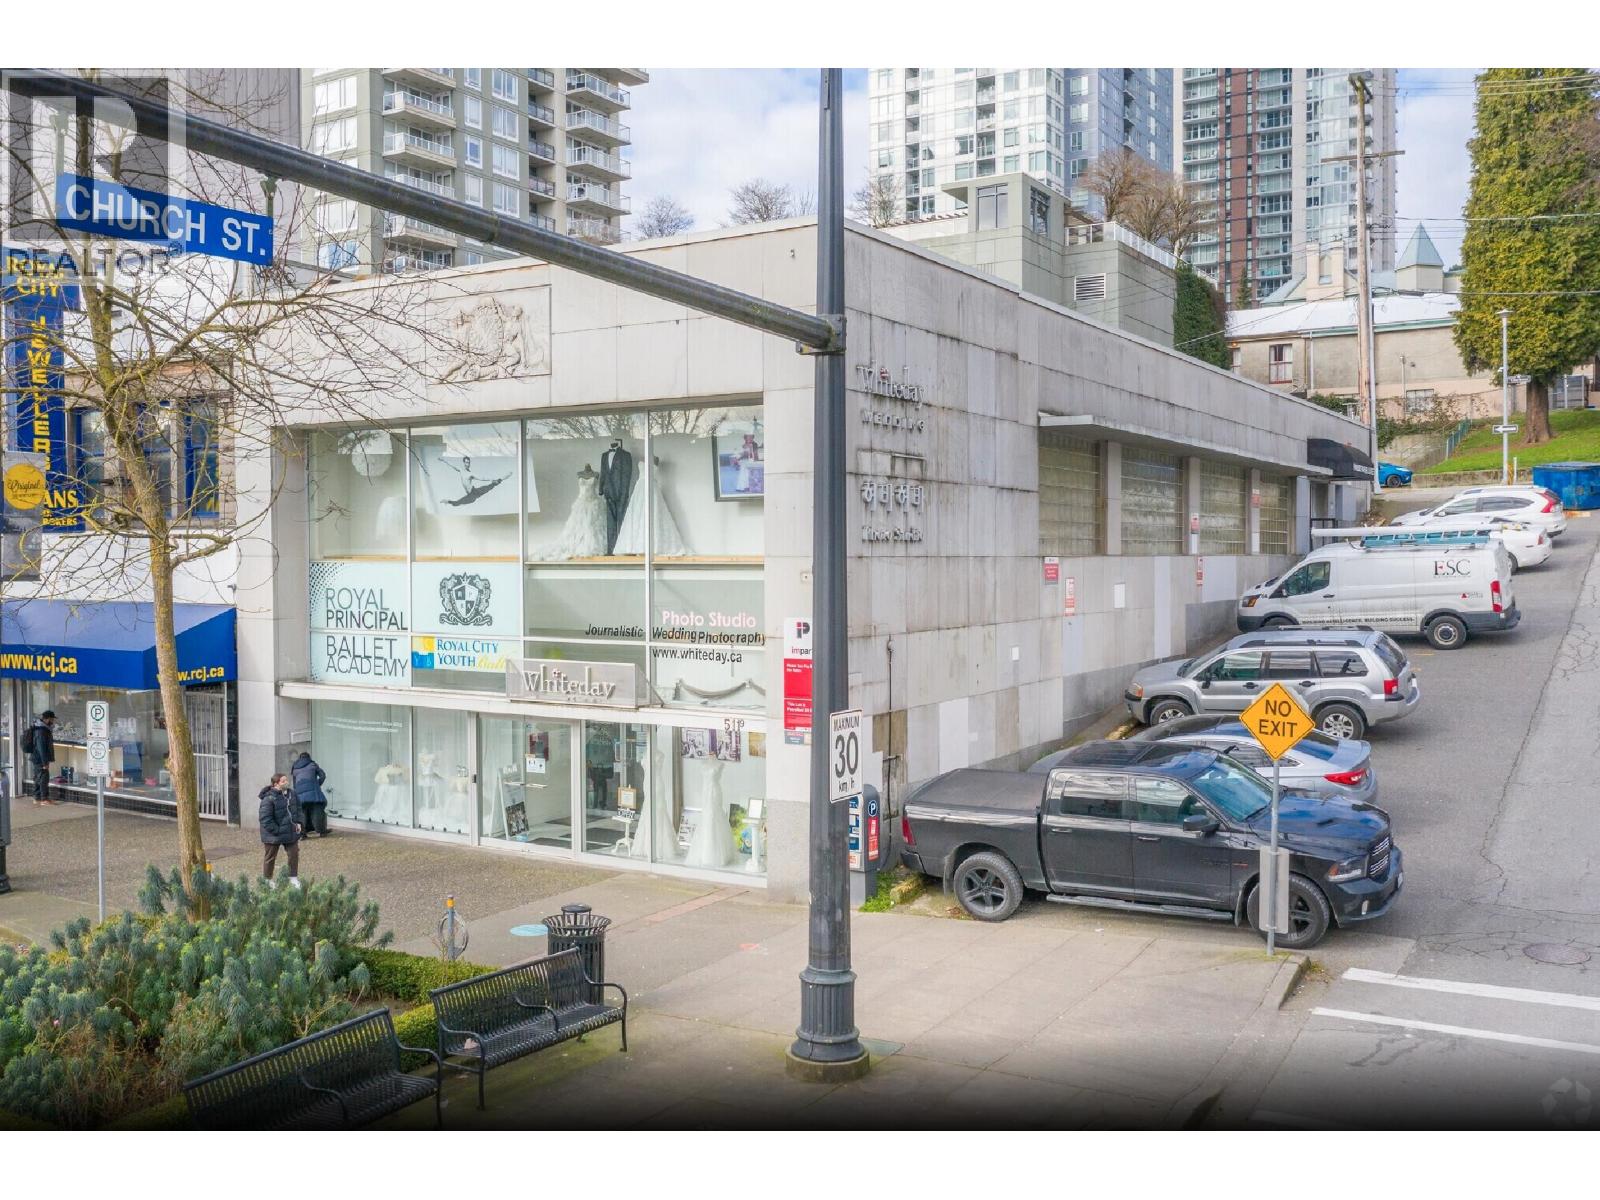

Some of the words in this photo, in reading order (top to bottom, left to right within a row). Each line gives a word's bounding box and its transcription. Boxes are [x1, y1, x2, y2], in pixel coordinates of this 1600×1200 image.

[65, 184, 206, 244] CHURCH
[222, 218, 266, 256] ST.
[1433, 558, 1471, 576] ESC
[325, 587, 389, 611] ROYAL
[326, 610, 409, 631] PRINCIPAL
[662, 610, 704, 627] Photo
[708, 611, 757, 628] Studio
[585, 624, 644, 638] Journalistic
[652, 627, 697, 642] Wedding
[326, 635, 398, 661] BALLET
[437, 639, 470, 652] ROYAL
[472, 640, 499, 654] CITY
[791, 646, 813, 656] impar
[0, 653, 78, 677] www.rcj.ca
[438, 653, 476, 667] YOUTH
[652, 648, 743, 665] www.whiteday.ca
[157, 666, 225, 684] w.rcj.ca
[325, 655, 409, 678] ACADEMY
[521, 664, 616, 700] Whiteday
[1265, 700, 1292, 717] NO
[1259, 719, 1298, 738] EXIT
[835, 732, 859, 778] 30
